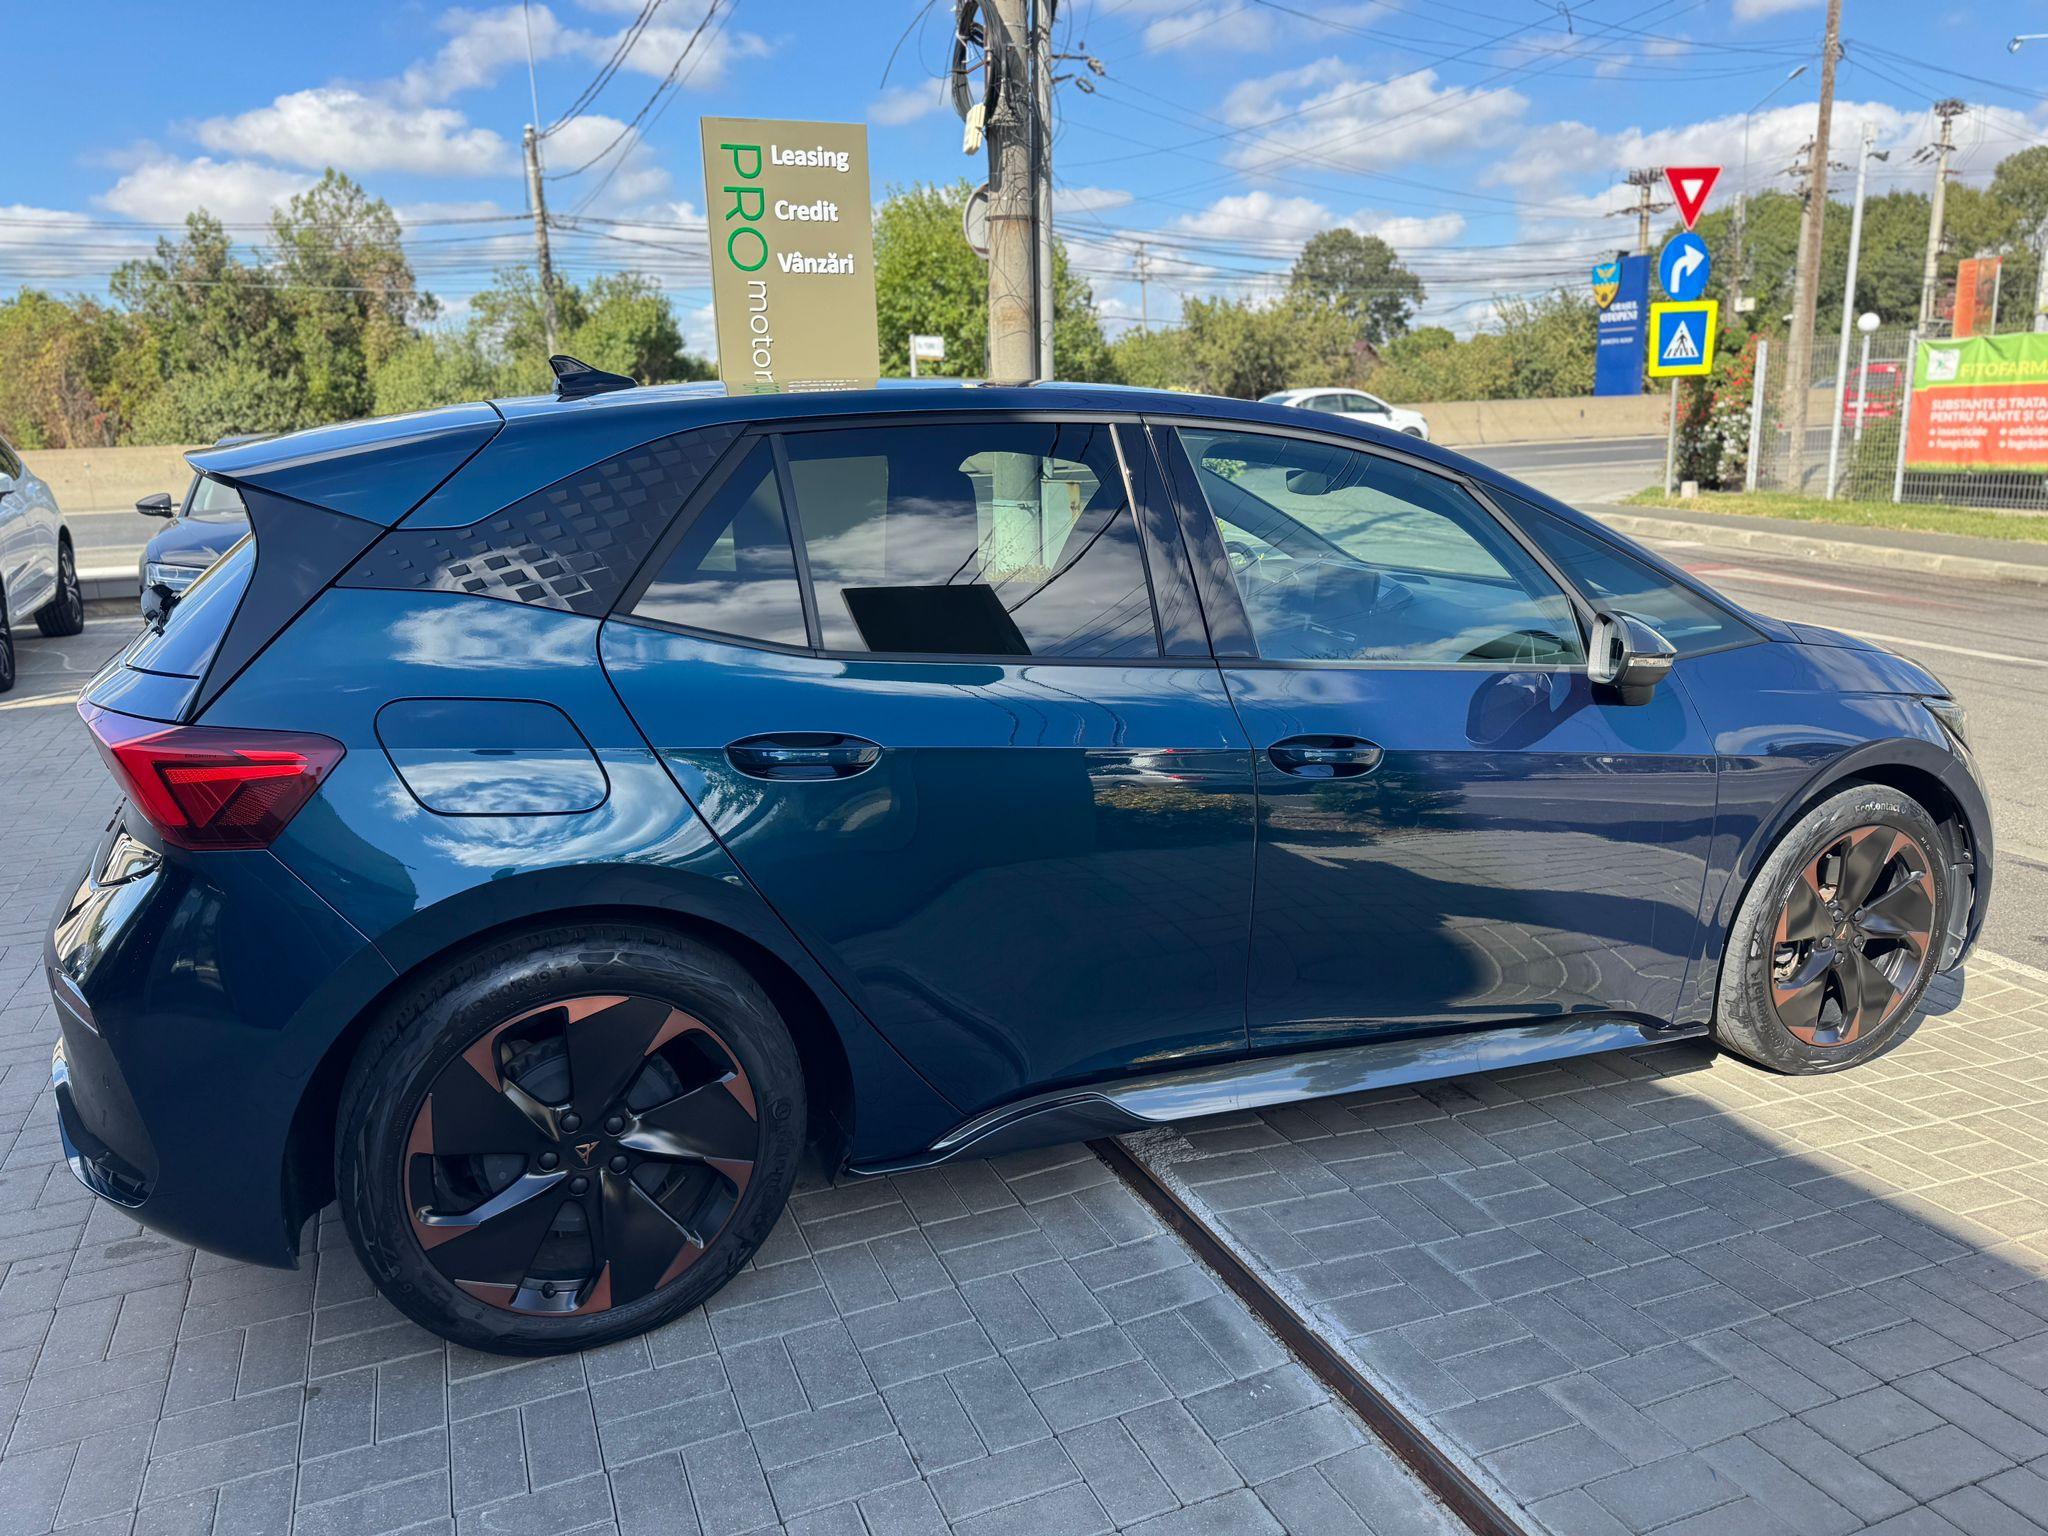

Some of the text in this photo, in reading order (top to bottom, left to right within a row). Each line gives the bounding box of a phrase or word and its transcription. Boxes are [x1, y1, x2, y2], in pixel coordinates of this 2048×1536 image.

[771, 144, 850, 172] Leasing
[774, 200, 839, 222] Credit
[777, 251, 855, 274] Vânzări
[1961, 360, 2048, 378] FITOFARM
[1930, 410, 1974, 422] PENTRU
[1976, 410, 2020, 422] PLANTE
